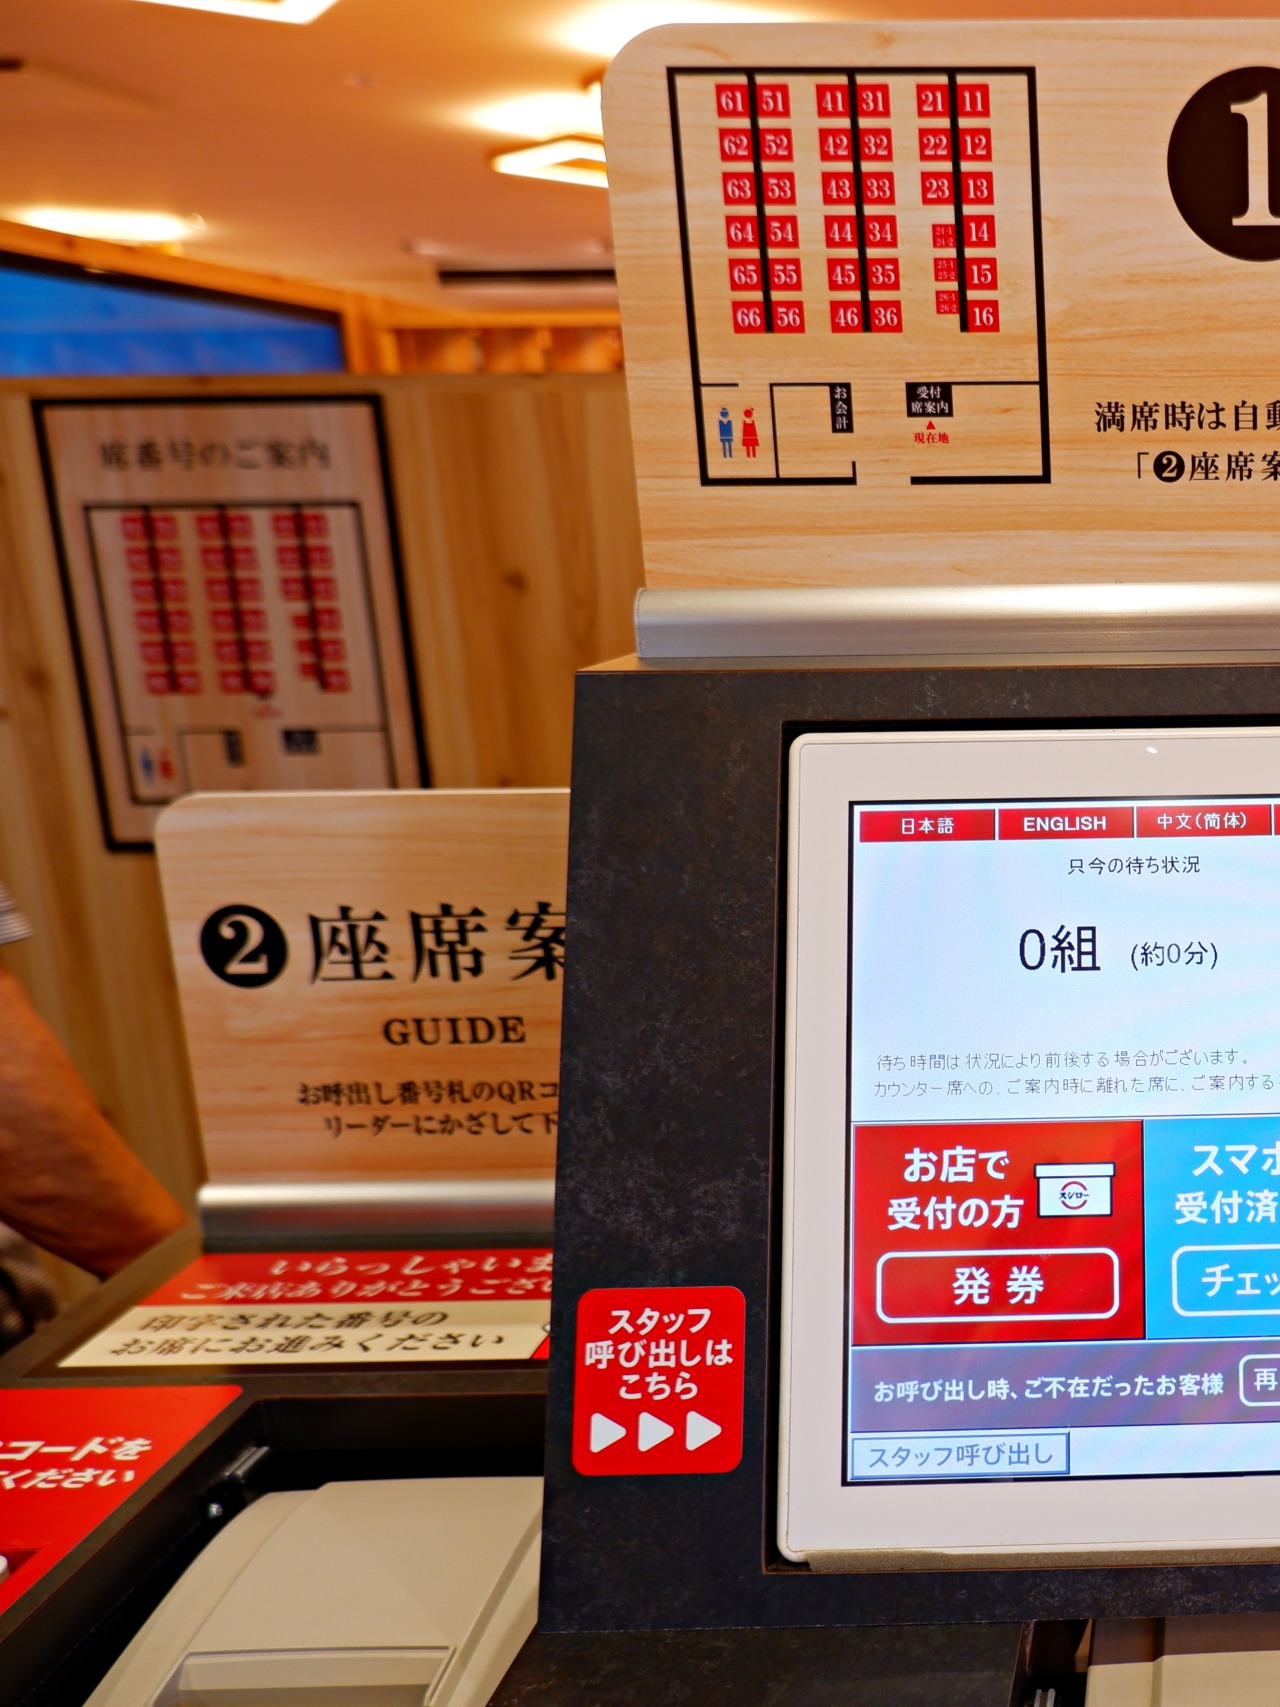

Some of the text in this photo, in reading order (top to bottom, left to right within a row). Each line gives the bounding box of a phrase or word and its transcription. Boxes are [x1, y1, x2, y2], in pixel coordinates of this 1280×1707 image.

[720, 90, 983, 112] 61 51 41 31 21 11
[723, 134, 987, 156] 62 52 42 32 22 12
[727, 178, 988, 199] 63 53 43 33 23 13
[729, 222, 754, 243] 64
[770, 221, 794, 242] 54
[829, 222, 854, 242] 44
[869, 222, 893, 242] 34
[969, 222, 990, 242] 14
[733, 264, 758, 284] 65
[774, 264, 798, 284] 55
[829, 264, 856, 285] 45
[872, 264, 895, 284] 35
[971, 264, 992, 284] 15
[737, 308, 761, 326] 66
[777, 307, 801, 327] 56
[835, 307, 859, 327] 46
[874, 307, 898, 326] 36
[973, 307, 994, 326] 16
[916, 386, 942, 399] 受付
[834, 386, 849, 430] お会計
[911, 401, 949, 414] 席案内
[913, 432, 950, 444] 現在地
[902, 818, 954, 834] 日本語
[1024, 816, 1106, 831] ENGLISH
[1068, 856, 1199, 875] 只今の待ち状況
[1020, 925, 1217, 973] 0組 (約0分)
[384, 1017, 525, 1045] GUIDE
[904, 1146, 1009, 1182] お店で
[888, 1195, 1023, 1230] 受付の方
[953, 1266, 1043, 1305] 発券
[138, 1309, 450, 1331] 印字された番号の
[609, 1308, 711, 1335] スタッフ
[108, 1330, 507, 1357] お席にお進みください
[586, 1339, 733, 1369] 呼び出しは
[620, 1372, 697, 1400] こちら
[875, 1373, 1223, 1402] お呼び出し時、ご不在だったお客様
[870, 1443, 1052, 1467] スタッフ呼び出し
